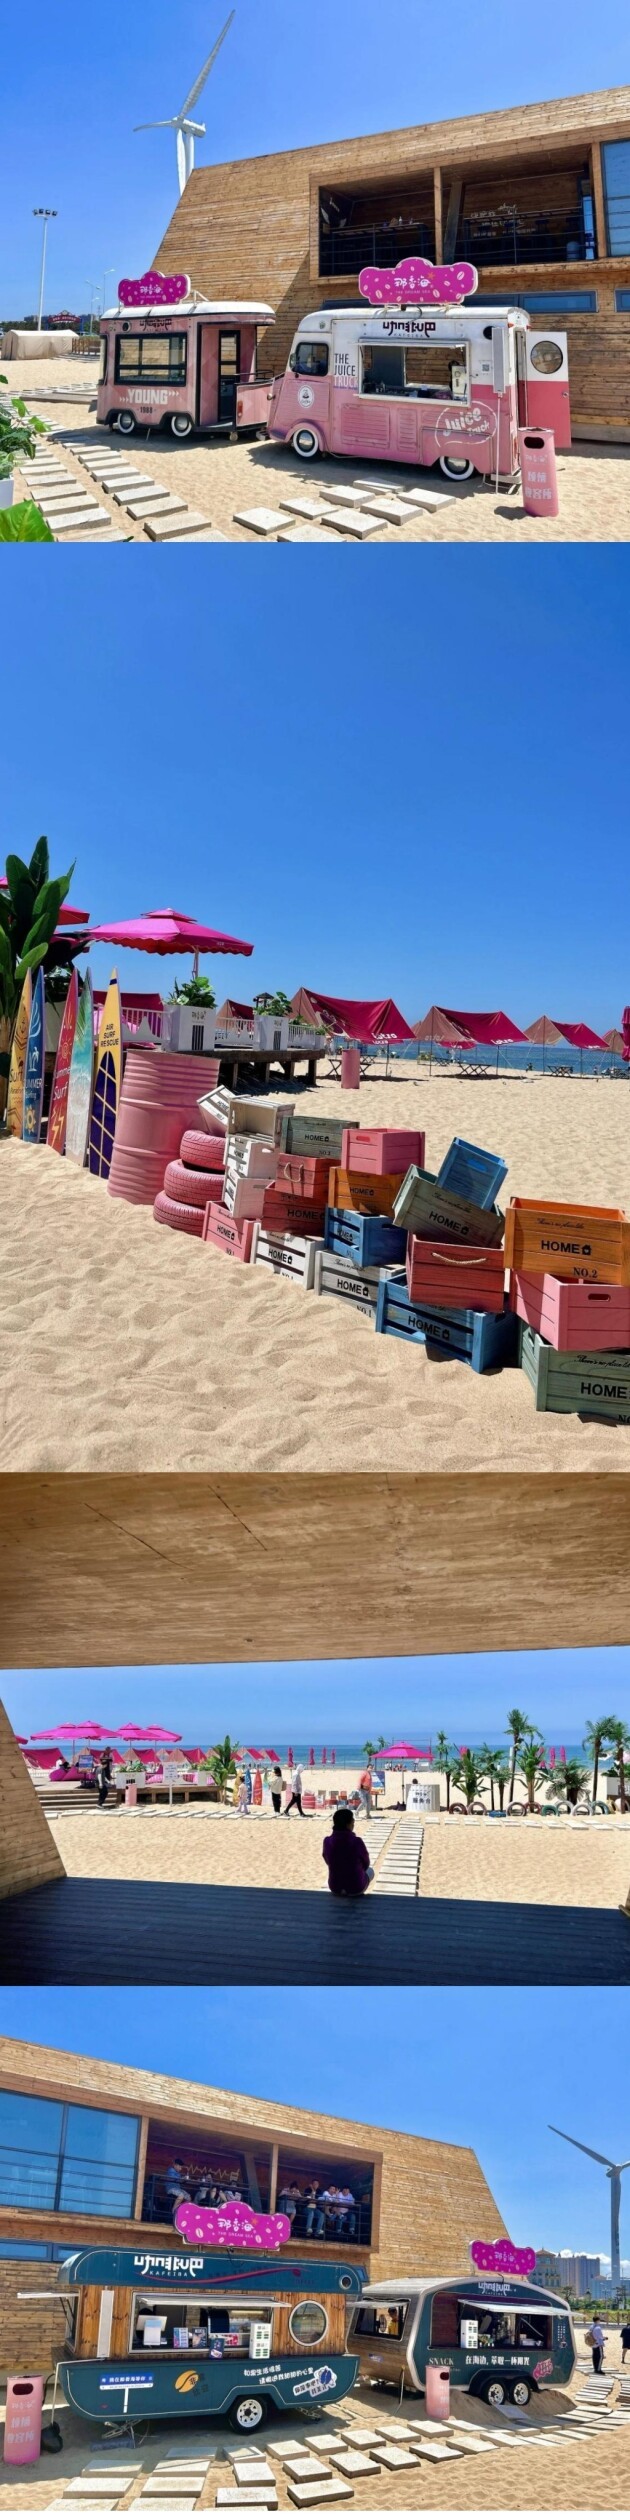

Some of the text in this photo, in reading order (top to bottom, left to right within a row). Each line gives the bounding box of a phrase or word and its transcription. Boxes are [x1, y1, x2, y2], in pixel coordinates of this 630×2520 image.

[394, 275, 431, 289] 那香海
[334, 353, 349, 364] THE
[334, 365, 356, 376] JUICE
[334, 375, 358, 388] TRUCK
[128, 389, 168, 405] YOUNG
[443, 407, 481, 437] Juice
[106, 1023, 114, 1031] AIR
[103, 1030, 116, 1039] SURF
[100, 1037, 119, 1047] RESCUE
[304, 1133, 324, 1142] HOME
[350, 1186, 367, 1195] HOME
[287, 1208, 318, 1220] HOME
[429, 1210, 462, 1234] HOME
[217, 1224, 231, 1238] HOME
[541, 1240, 580, 1254] HOME
[268, 1248, 288, 1262] HOME
[573, 1266, 598, 1279] NO.2
[337, 1279, 362, 1295] HOME
[407, 1315, 442, 1338] HOME
[580, 1382, 628, 1399] HOME
[217, 2217, 254, 2232] 那香海
[428, 2357, 454, 2365] SNACK
